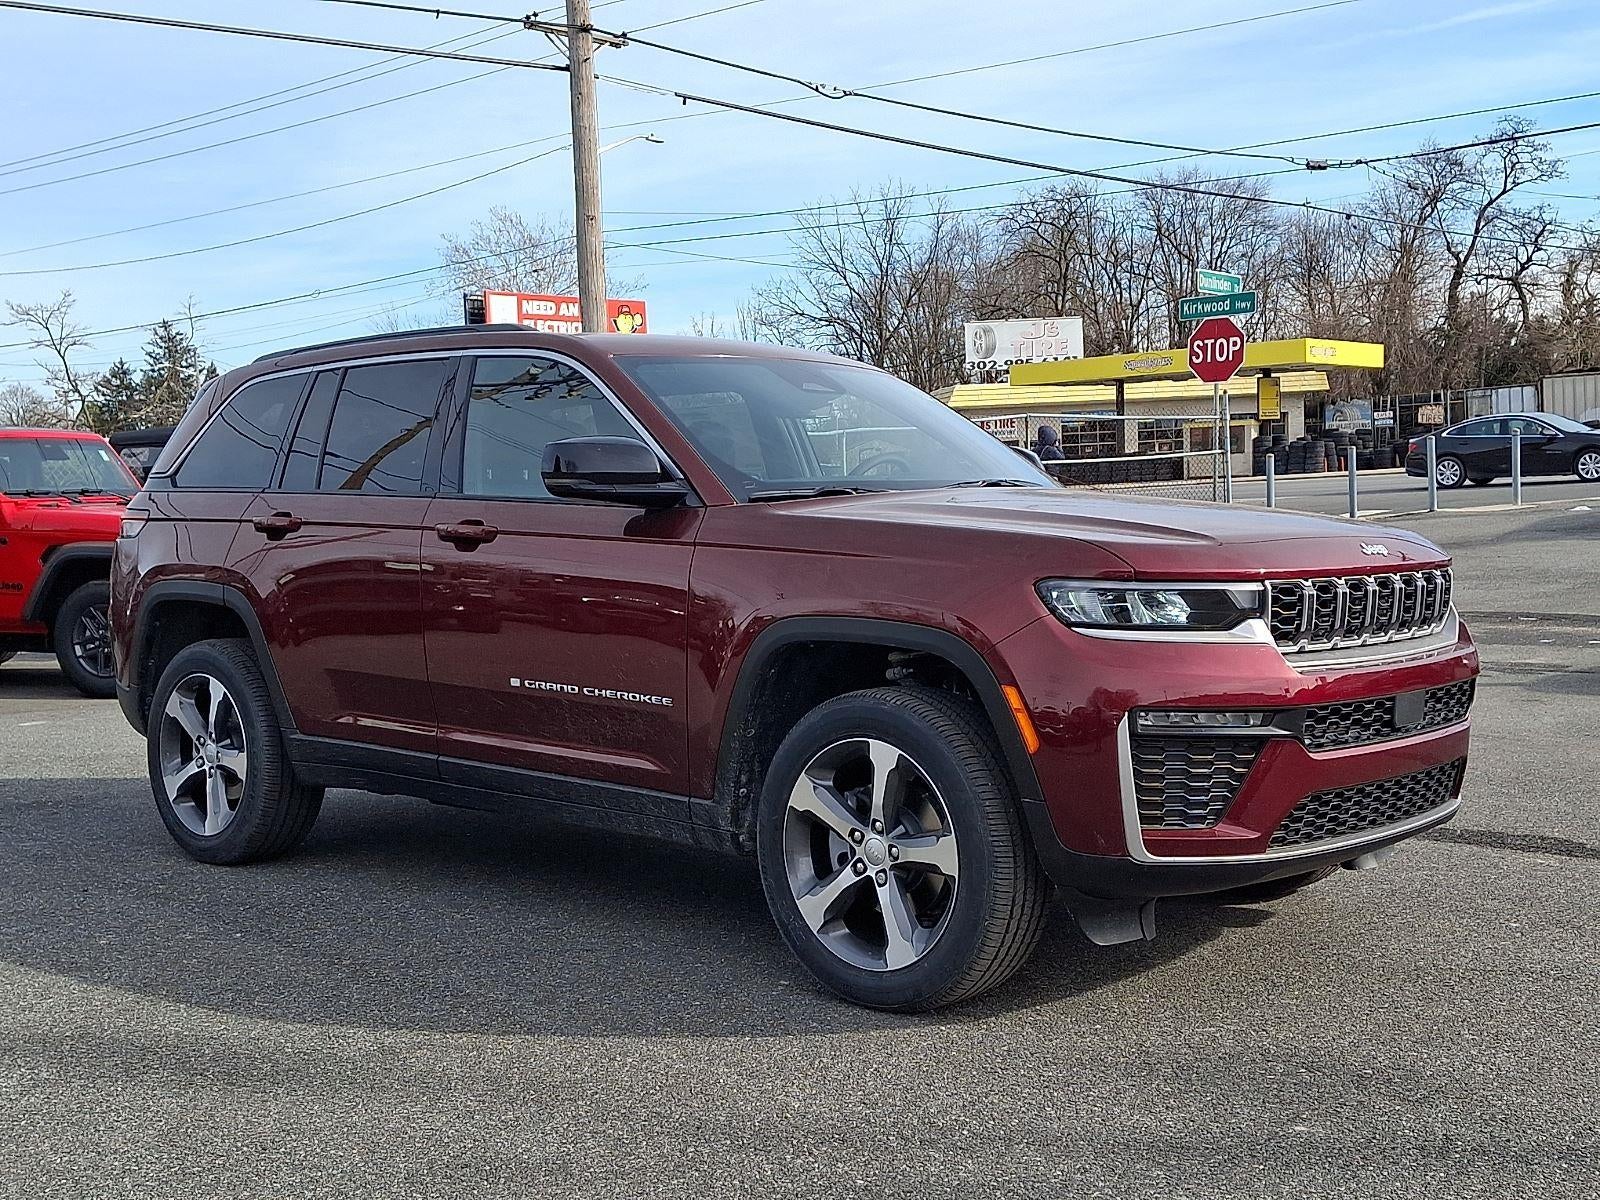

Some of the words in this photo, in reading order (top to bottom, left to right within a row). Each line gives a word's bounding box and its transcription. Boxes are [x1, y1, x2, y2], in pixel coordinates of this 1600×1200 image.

[522, 300, 557, 316] NEED
[559, 302, 579, 317] AN
[1183, 298, 1230, 315] Kirkwood
[1235, 301, 1251, 310] Hwy
[1011, 338, 1069, 358] TIRE
[1191, 336, 1241, 364] STOP
[1420, 414, 1443, 423] TIRES
[1360, 542, 1388, 557] Jeep
[524, 679, 579, 694] GRAND
[583, 687, 673, 707] CHEROKEE
